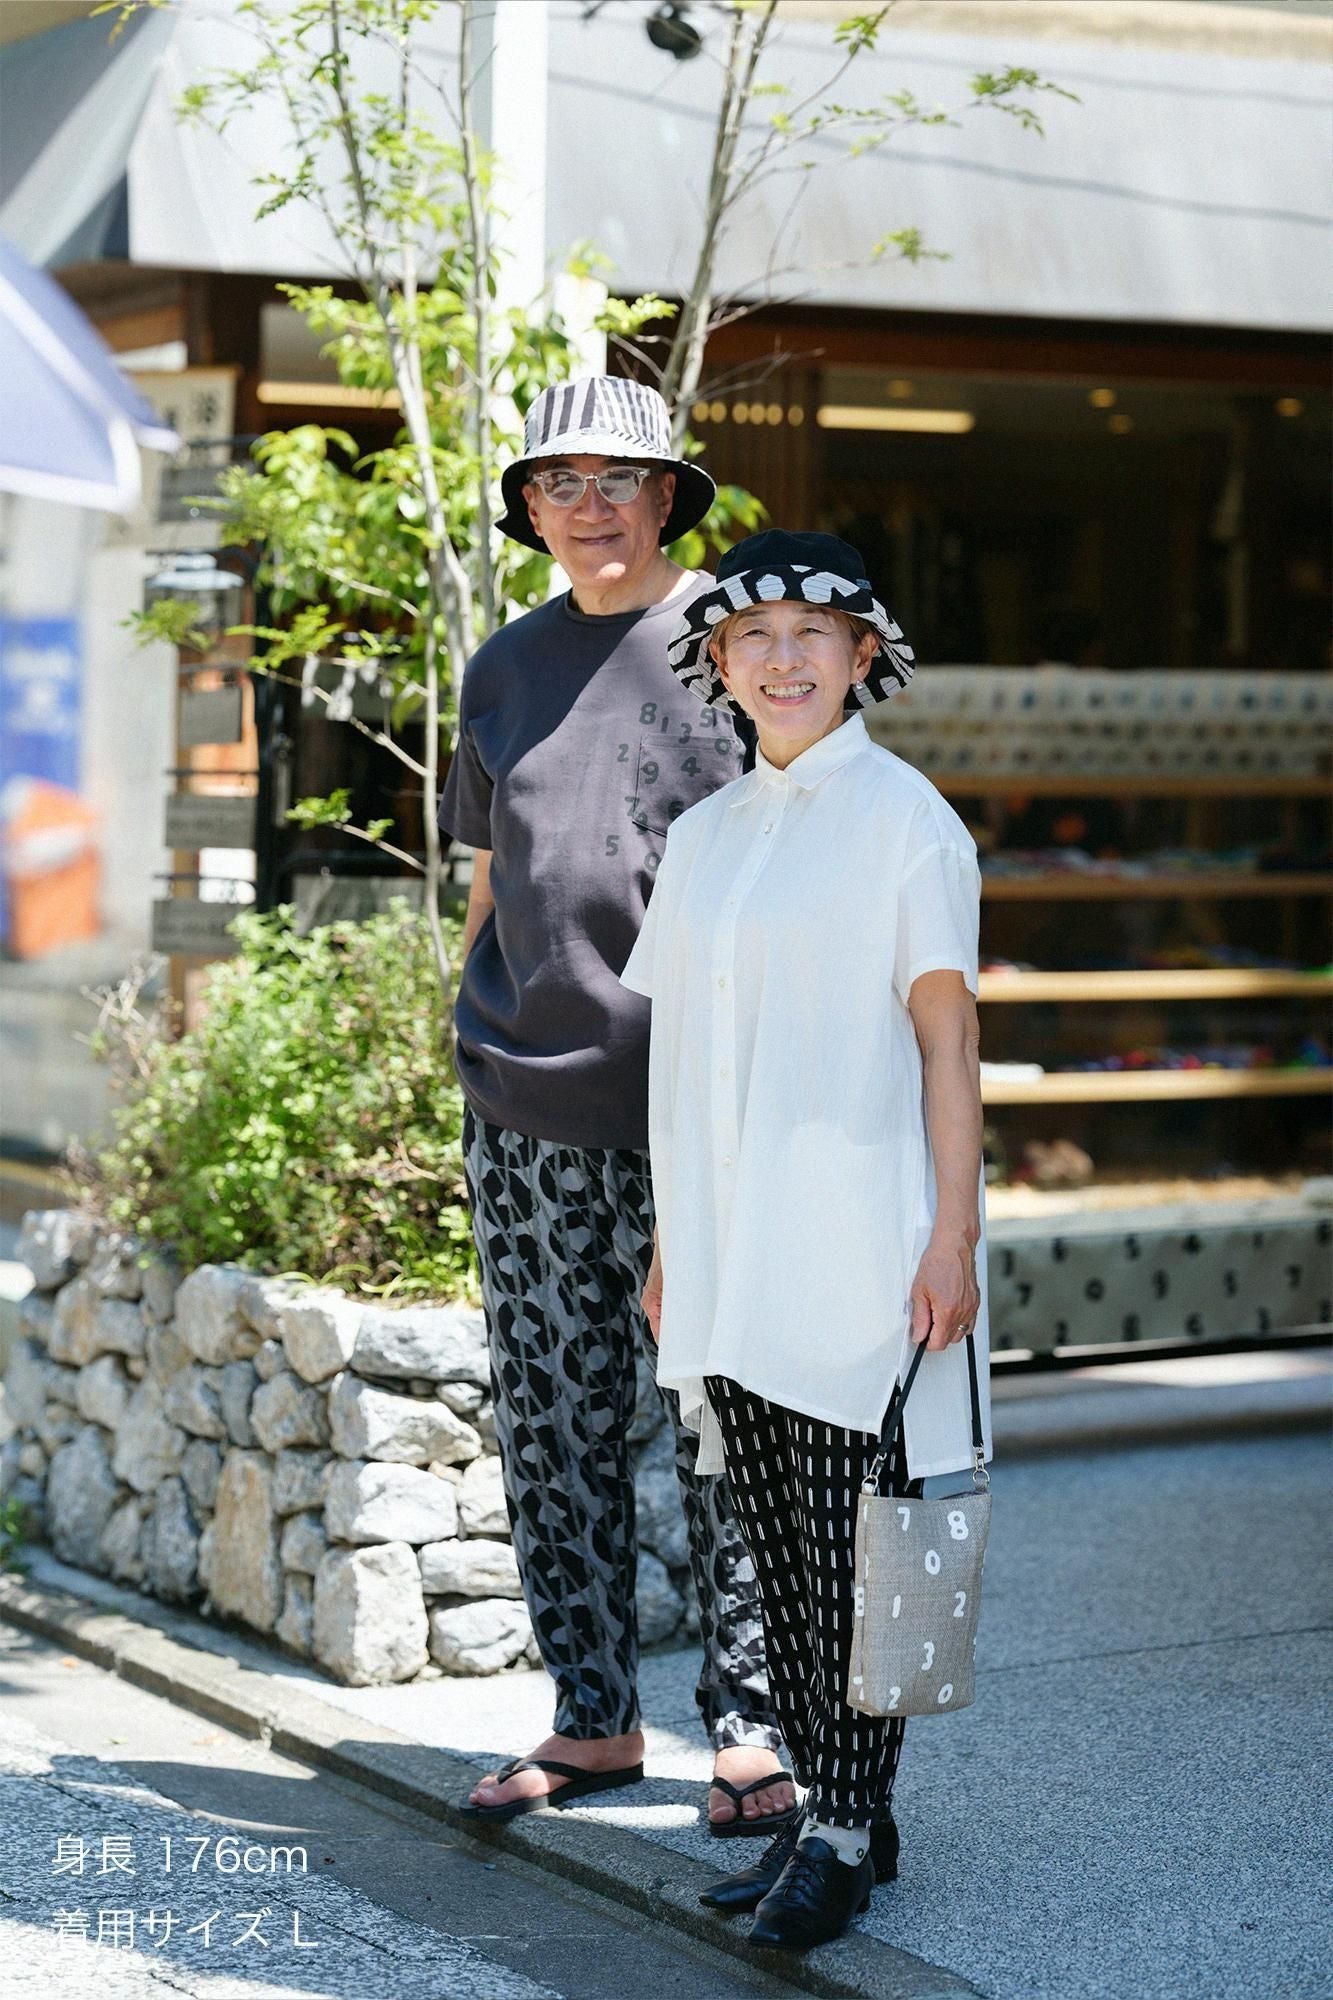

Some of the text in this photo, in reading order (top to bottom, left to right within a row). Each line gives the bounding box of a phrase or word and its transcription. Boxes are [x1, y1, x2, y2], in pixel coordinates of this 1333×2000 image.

[639, 702, 658, 725] 8
[678, 722, 692, 744] 3
[617, 743, 629, 762] 2
[641, 760, 659, 784] 9
[679, 756, 701, 777] 4
[605, 834, 620, 856] 5
[897, 1507, 969, 1540] 7 8
[924, 1549, 941, 1575] 0
[892, 1591, 966, 1618] 1 2
[921, 1641, 935, 1671] 3
[887, 1683, 954, 1710] 2 0
